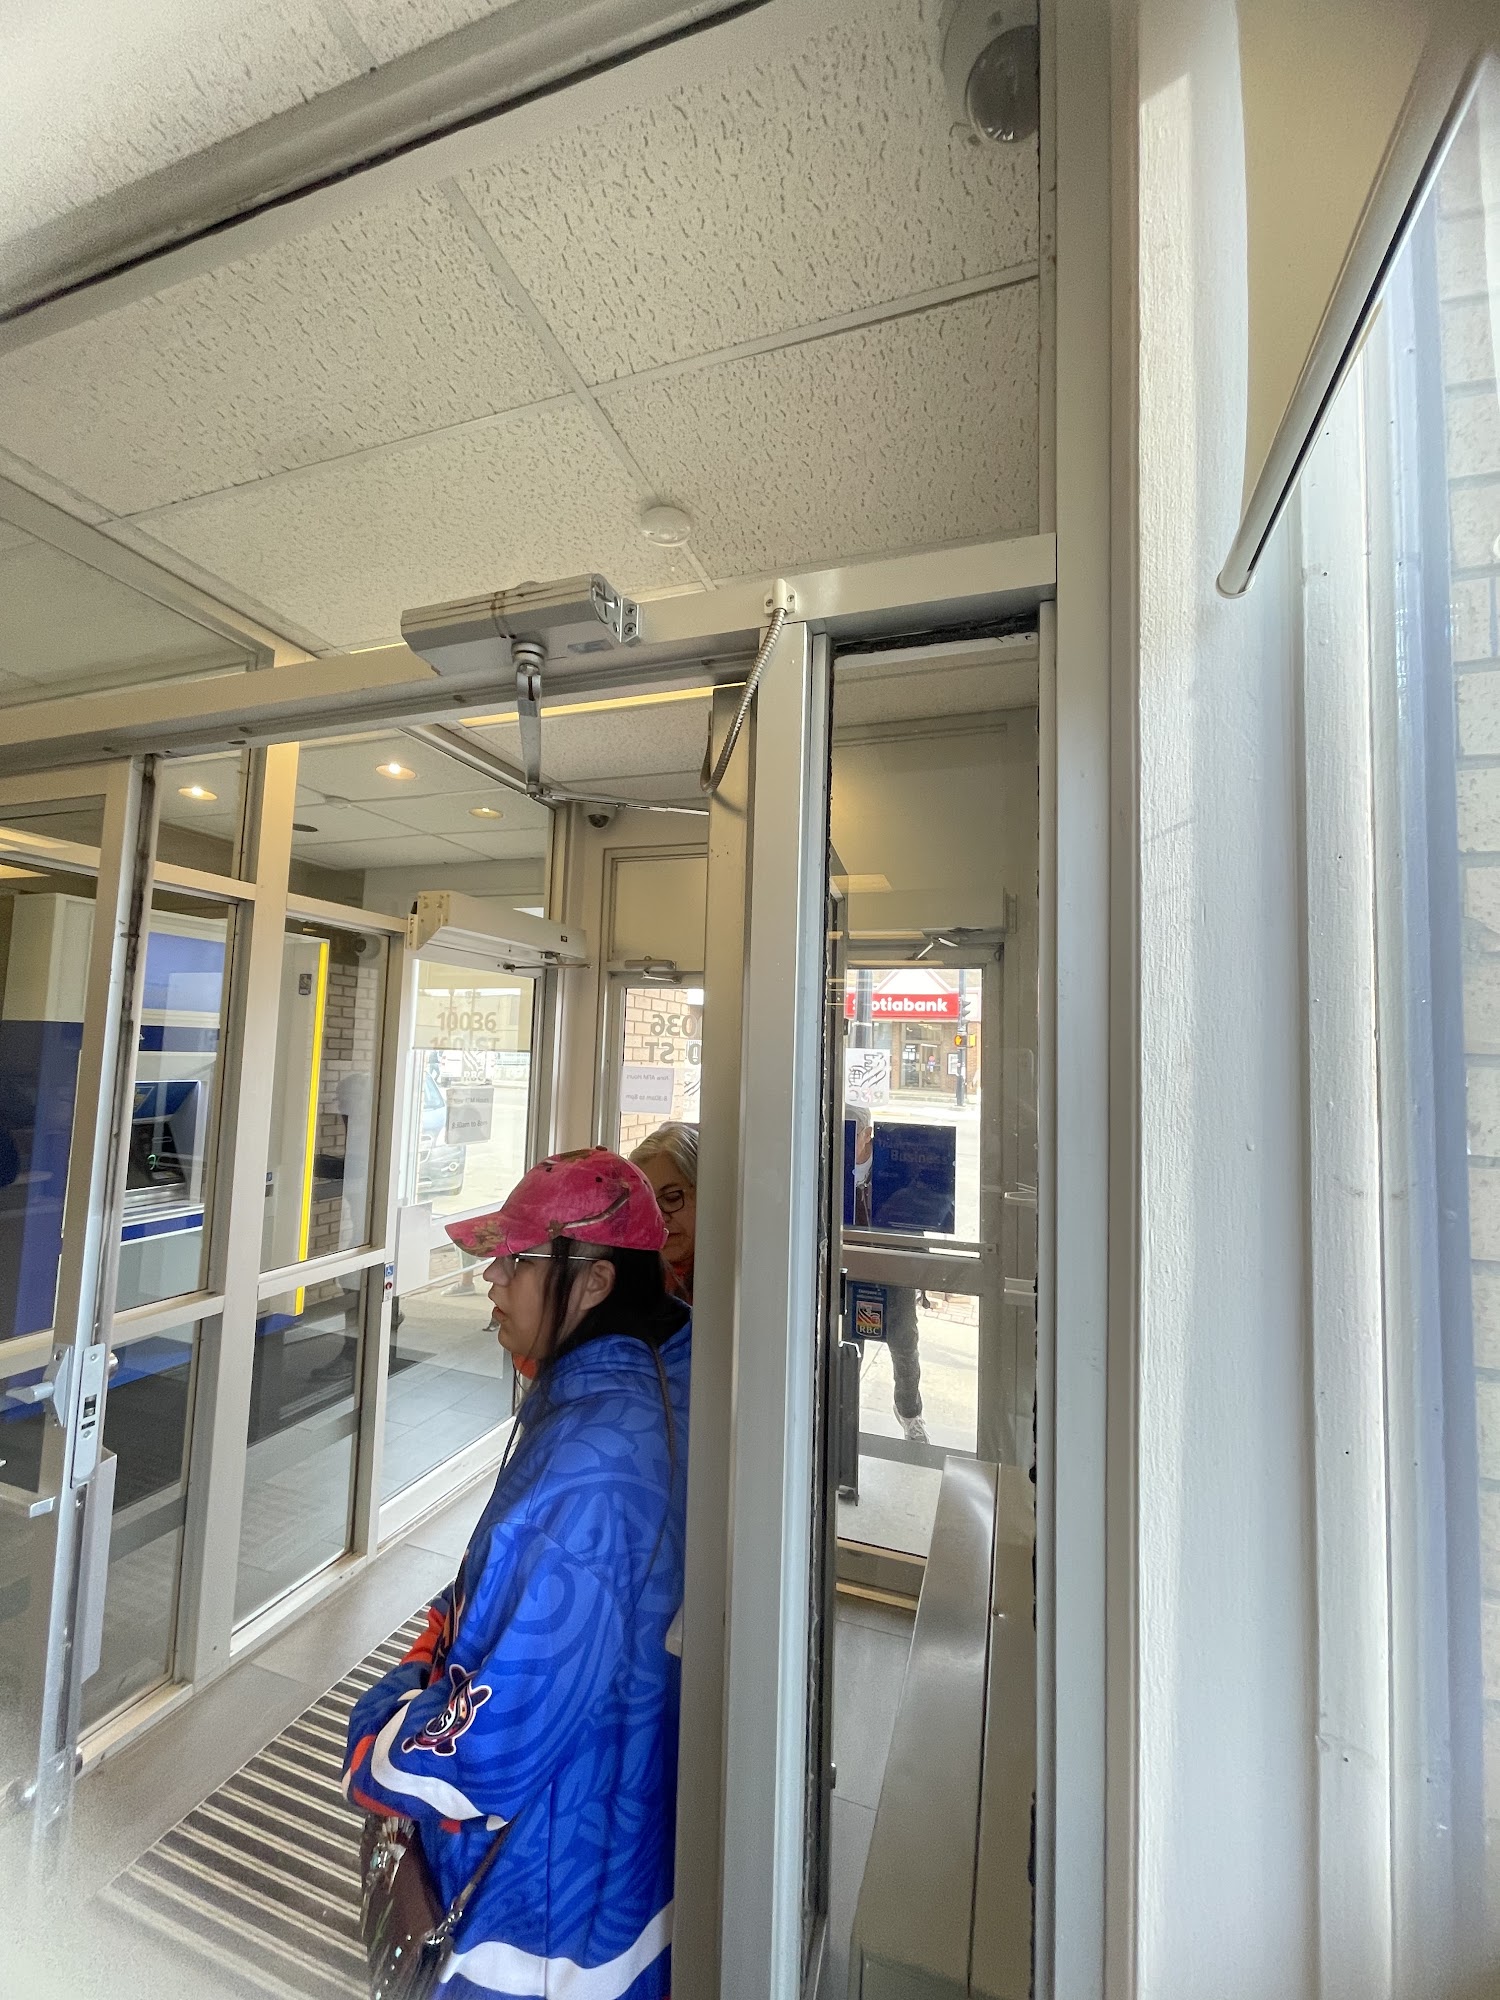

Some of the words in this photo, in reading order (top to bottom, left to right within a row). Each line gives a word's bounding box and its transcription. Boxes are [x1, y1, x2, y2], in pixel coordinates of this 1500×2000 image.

[852, 997, 947, 1012] otiabank
[437, 1011, 496, 1031] 10036
[860, 1325, 880, 1335] RBC
